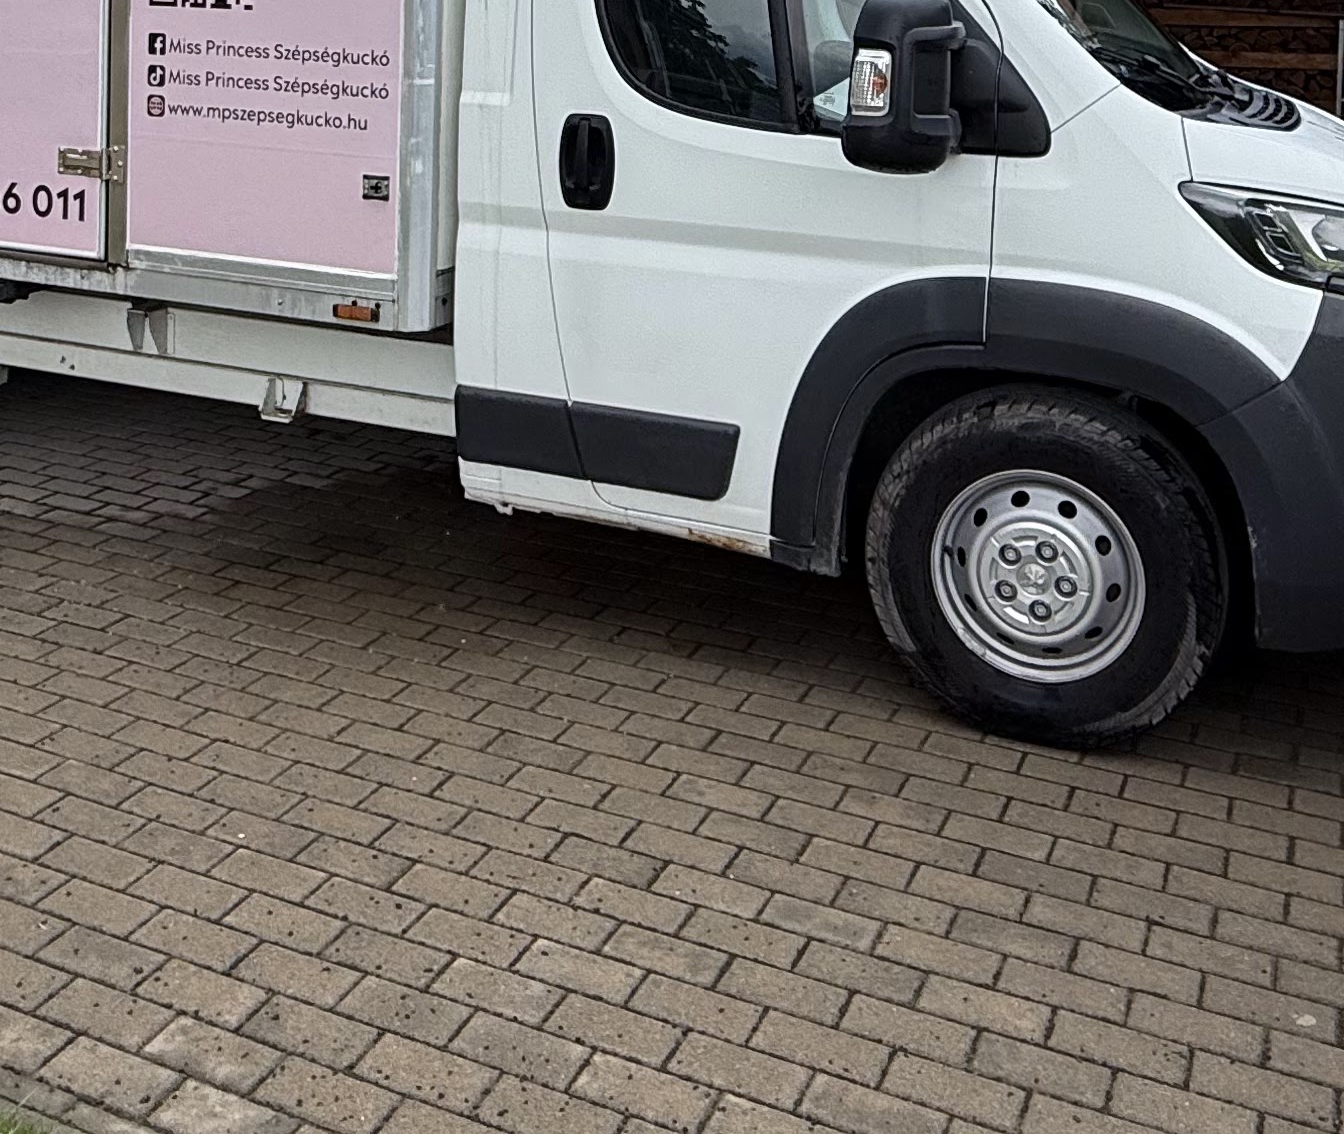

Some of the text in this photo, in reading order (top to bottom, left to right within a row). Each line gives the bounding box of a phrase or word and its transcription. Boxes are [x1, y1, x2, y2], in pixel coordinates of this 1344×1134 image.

[168, 38, 202, 55] Miss
[205, 39, 271, 59] Princess
[273, 43, 390, 68] Szépségkuckó
[168, 69, 390, 100] Miss Princess Szépségkuckó
[167, 104, 368, 131] www.mpszepsegkucko.hu
[32, 184, 86, 223] 011
